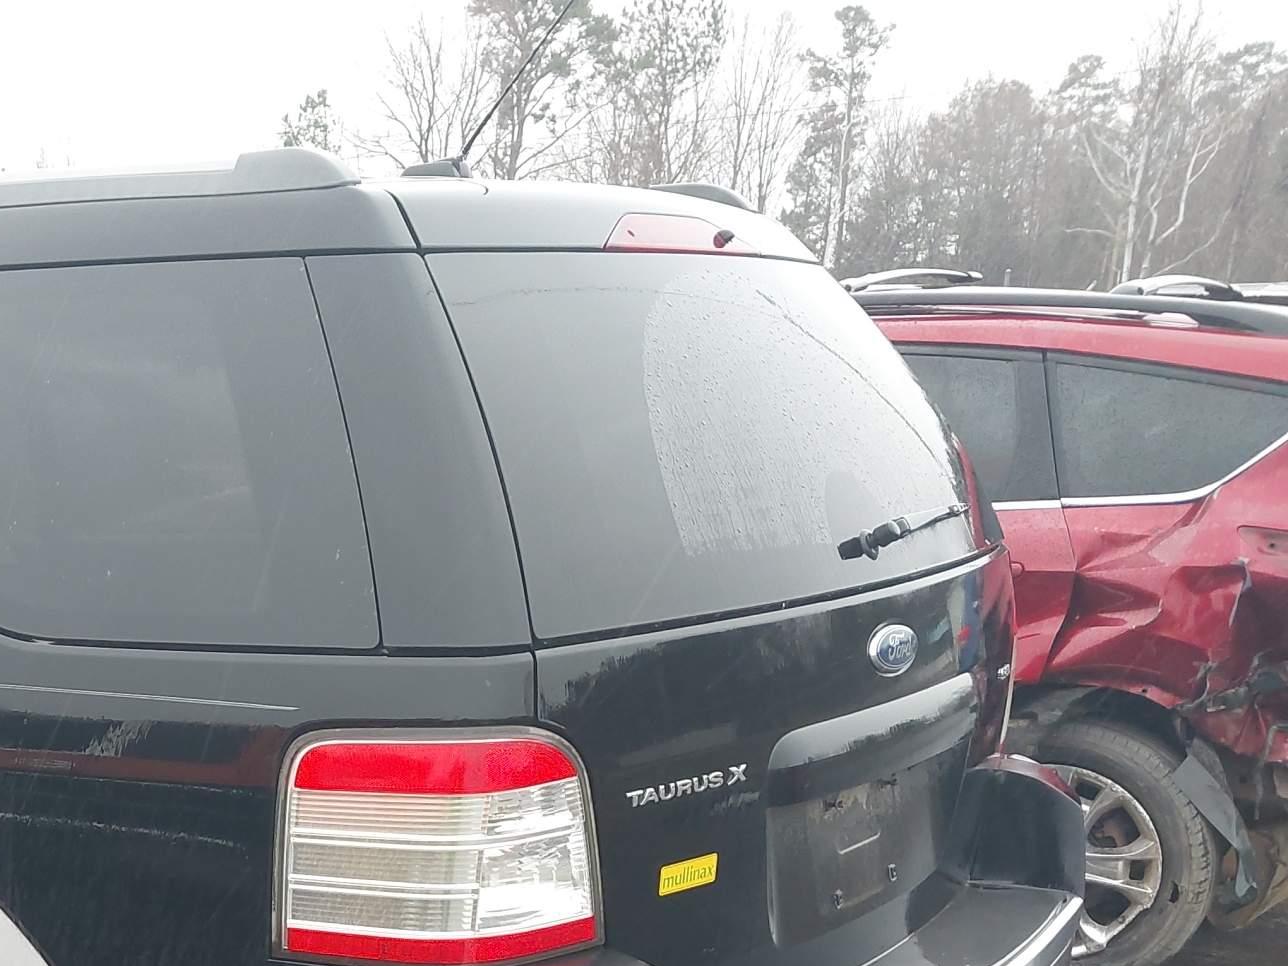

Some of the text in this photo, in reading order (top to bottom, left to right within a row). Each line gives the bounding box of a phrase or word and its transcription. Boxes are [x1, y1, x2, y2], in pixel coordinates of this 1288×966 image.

[888, 631, 913, 661] Ford
[625, 763, 748, 808] TAURUS X
[662, 864, 715, 890] mullinax
